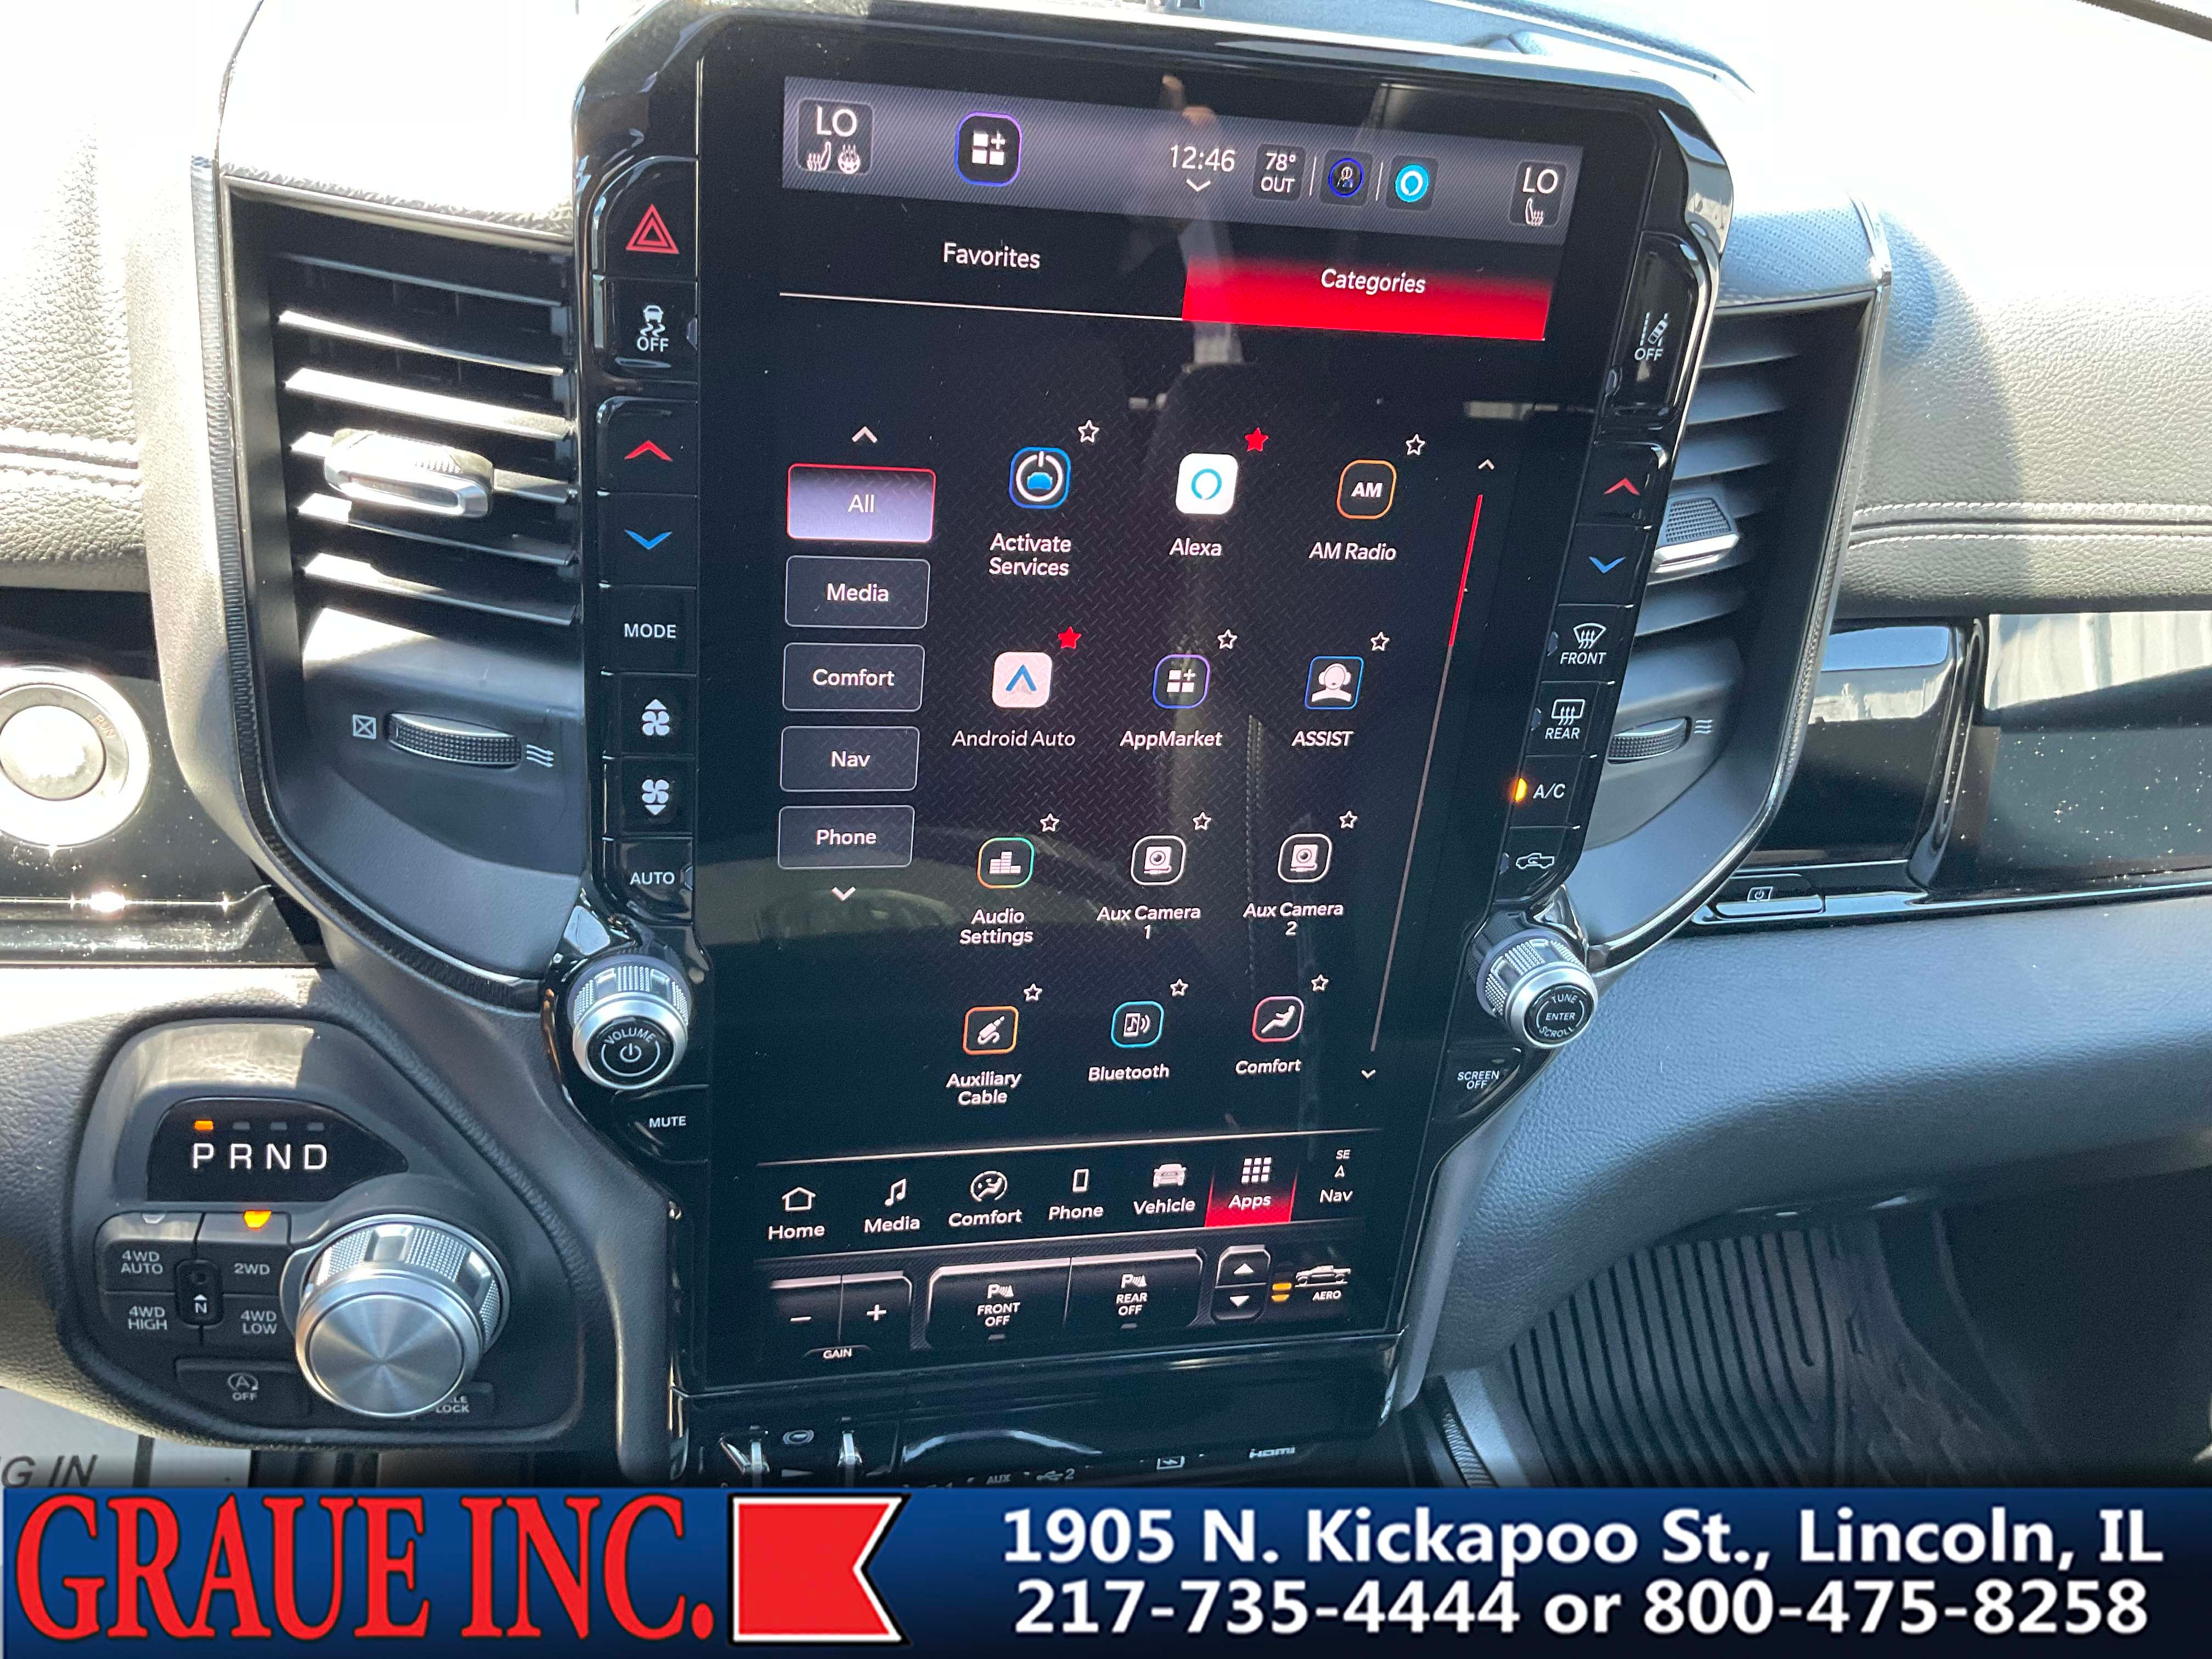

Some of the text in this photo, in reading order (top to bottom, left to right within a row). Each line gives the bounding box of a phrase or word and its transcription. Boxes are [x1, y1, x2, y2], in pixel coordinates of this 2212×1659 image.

[816, 105, 857, 137] LO
[1170, 145, 1236, 173] 12:46
[1265, 153, 1296, 171] 78°
[1261, 176, 1295, 193] OUT
[1522, 167, 1559, 194] LO
[943, 242, 1041, 269] Favorites
[1321, 268, 1426, 295] Categories
[636, 336, 669, 352] OFF
[1634, 348, 1663, 362] OFF
[1351, 482, 1383, 498] AM
[848, 494, 875, 514] All
[989, 533, 1071, 553] Activate
[1169, 537, 1222, 556] Alexa
[1308, 542, 1397, 561] AM Radio
[989, 557, 1069, 577] Services
[826, 583, 889, 602] Media
[624, 623, 677, 639] MODE
[1560, 652, 1607, 665] FRONT
[812, 668, 895, 687] Comfort
[952, 730, 1076, 747] Android Auto
[1120, 731, 1223, 750] AppMarket
[1291, 731, 1354, 747] ASSIST
[1544, 727, 1580, 740] REAR
[831, 751, 871, 768] Nav
[1533, 783, 1566, 799] A/C
[816, 830, 877, 846] Phone
[629, 871, 675, 885] AUTO
[971, 908, 1025, 924] Audio
[1096, 906, 1201, 922] Aux Camera
[1243, 902, 1344, 918] Aux Camera
[1143, 924, 1152, 940] 1
[1285, 921, 1297, 936] 2
[960, 928, 1034, 947] Settings
[1551, 993, 1578, 1004] TUNE
[1545, 1012, 1576, 1021] ENTER
[604, 1027, 656, 1045] VOLUME
[1538, 1025, 1574, 1038] SCROLL
[1088, 1063, 1170, 1082] Bluetooth
[1235, 1058, 1301, 1075] Comfort
[945, 1071, 1022, 1089] Auxiliary
[1457, 1070, 1500, 1081] SCREEN
[1466, 1080, 1488, 1090] OFF
[957, 1088, 1008, 1106] Cable
[649, 1115, 687, 1128] MUTE
[1335, 1149, 1351, 1160] SE
[1228, 1194, 1272, 1210] Apps
[1319, 1189, 1353, 1204] Nav
[1048, 1205, 1104, 1221] Phone
[1133, 1198, 1196, 1215] Vehicle
[864, 1215, 921, 1234] Media
[948, 1209, 1023, 1228] Comfort
[768, 1224, 825, 1241] Home
[122, 1250, 160, 1262] 4WD
[120, 1262, 163, 1275] AUTO
[234, 1262, 270, 1275] 2WD
[1115, 1293, 1148, 1305] REAR
[1312, 1290, 1342, 1301] AERO
[129, 1306, 165, 1318] 4WD
[194, 1302, 207, 1314] N
[240, 1310, 277, 1322] 4WD
[977, 1302, 1021, 1316] FRONT
[1118, 1304, 1143, 1316] OFF
[127, 1318, 168, 1330] HIGH
[242, 1322, 278, 1335] LOW
[984, 1314, 1011, 1328] OFF
[823, 1347, 853, 1359] GAIN
[232, 1391, 258, 1402] OFF
[986, 1474, 1012, 1485] AUX
